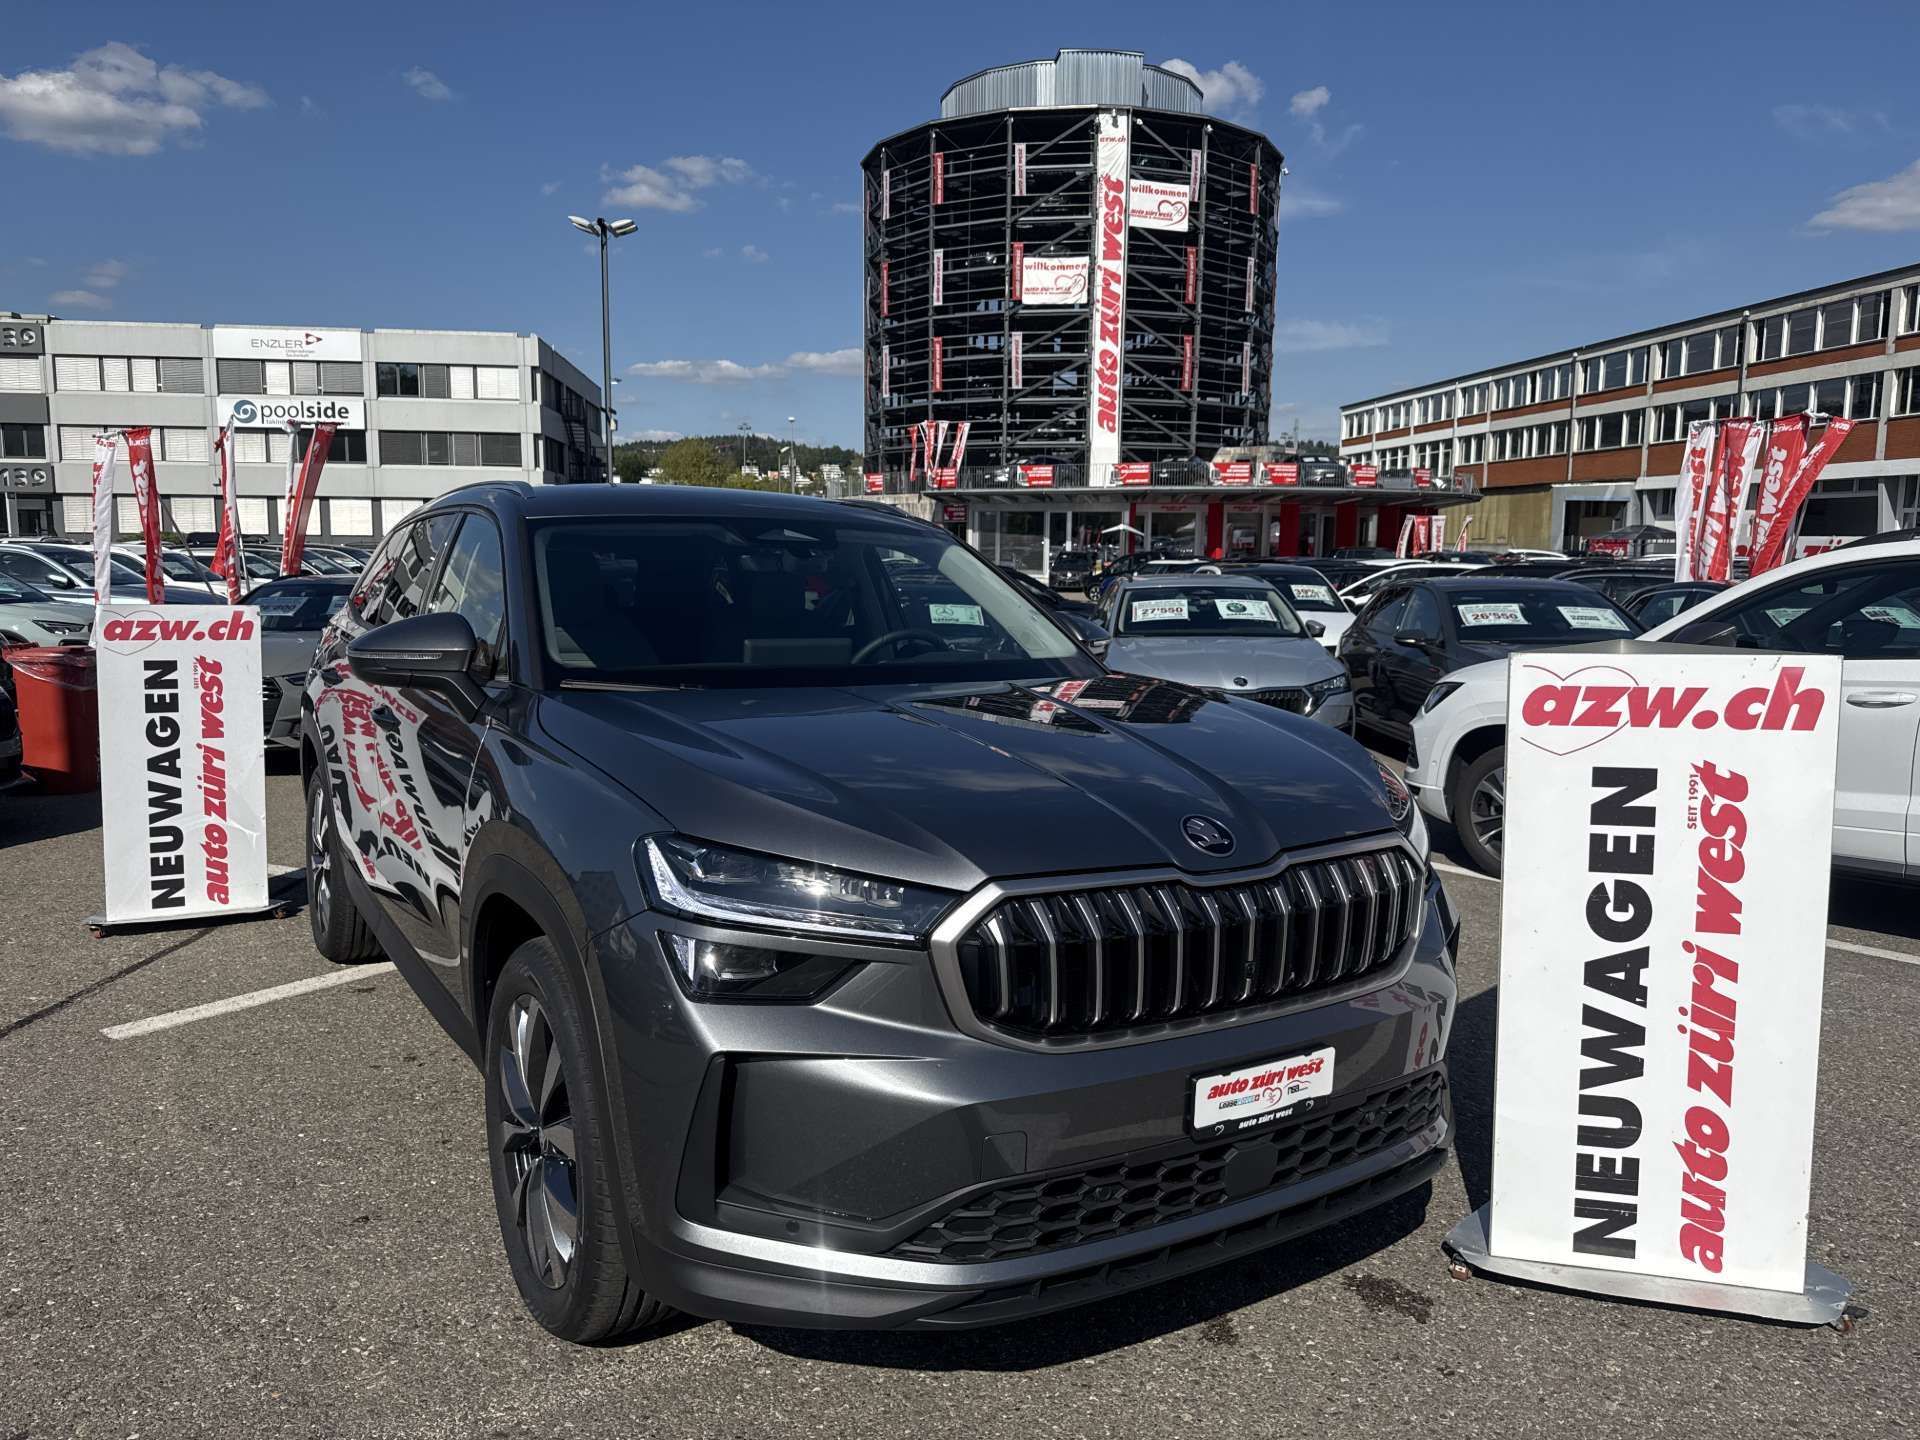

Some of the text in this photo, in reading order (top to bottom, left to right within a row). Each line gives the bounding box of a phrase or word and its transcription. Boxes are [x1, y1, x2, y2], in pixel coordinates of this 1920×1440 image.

[1131, 184, 1188, 198] willkommen
[1024, 261, 1087, 271] willkommen
[1095, 173, 1125, 433] auto züri west
[251, 338, 304, 349] ENZLER
[261, 400, 350, 425] poolside
[1760, 445, 1788, 515] west
[103, 610, 255, 642] azw.ch
[1522, 666, 1825, 732] azw.ch
[143, 659, 186, 910] NEUWAGEN
[194, 655, 230, 906] auto züri west
[1687, 774, 1699, 830] SEIT 1991
[1572, 765, 1659, 1260] NEUWAGEN
[1673, 760, 1750, 1274] auto züri west
[1208, 1058, 1324, 1100] auto züri west
[1238, 1107, 1293, 1129] auto züri west
